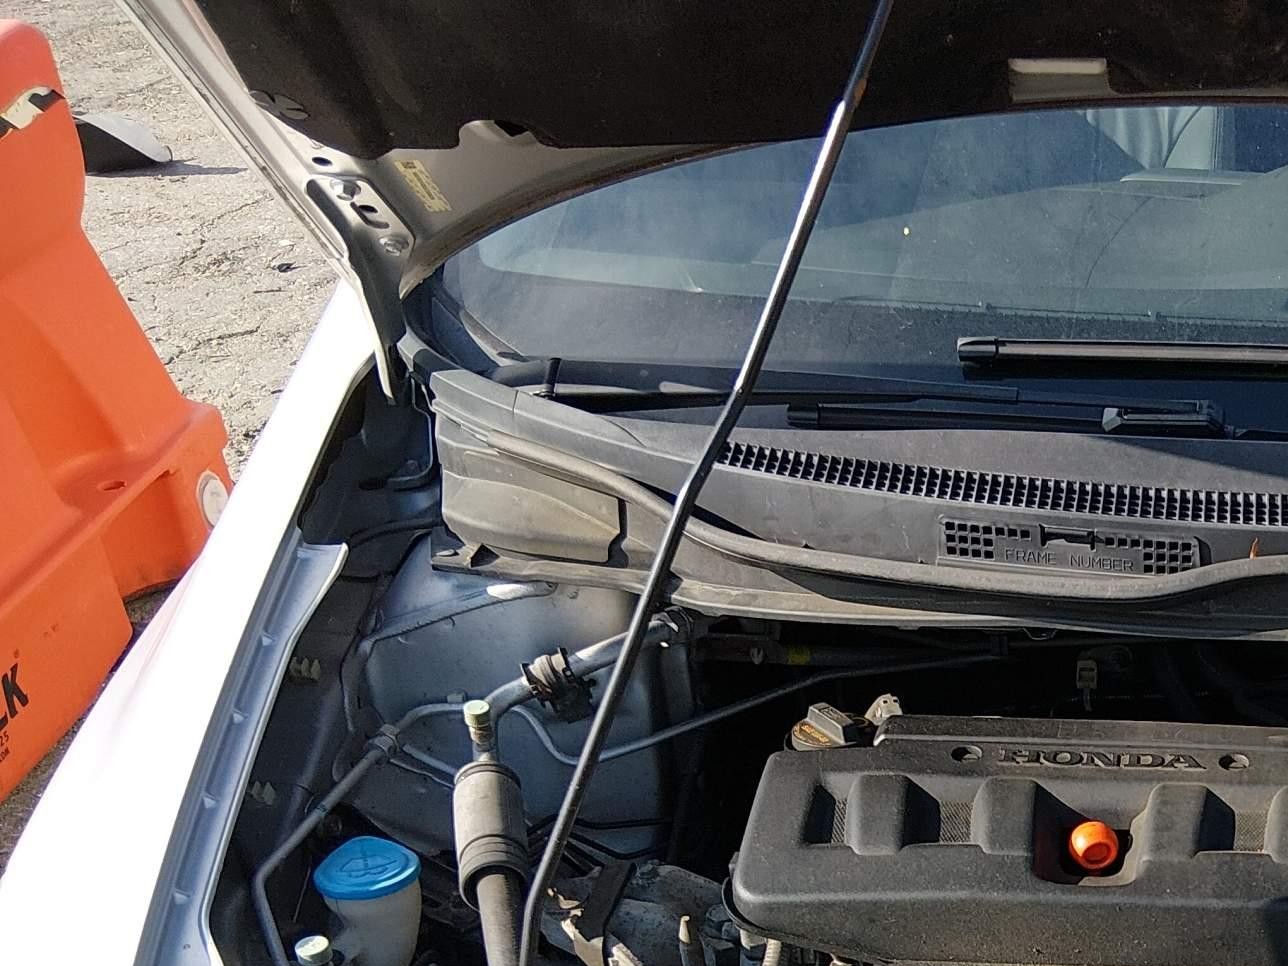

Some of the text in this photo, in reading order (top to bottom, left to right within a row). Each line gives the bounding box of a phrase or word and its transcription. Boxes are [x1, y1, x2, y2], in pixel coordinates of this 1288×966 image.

[1005, 548, 1134, 572] FRAME NUMBER
[998, 748, 1207, 771] HONDA
